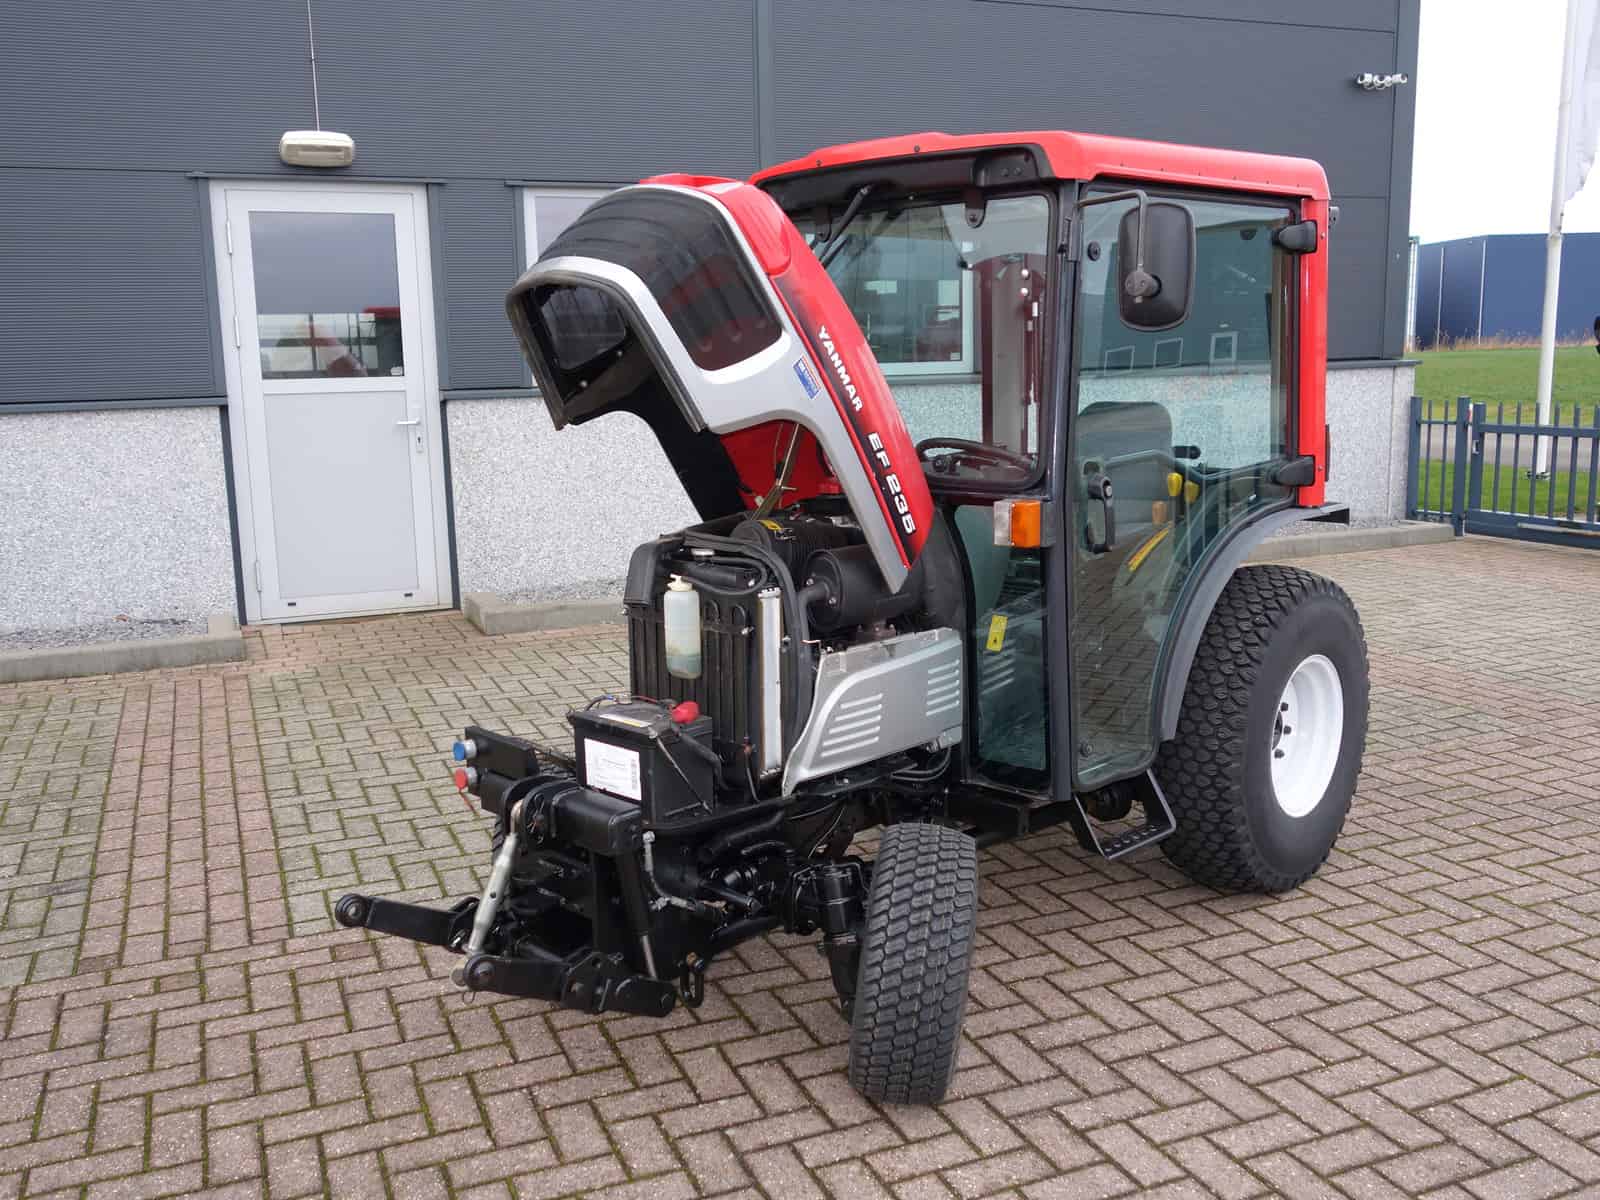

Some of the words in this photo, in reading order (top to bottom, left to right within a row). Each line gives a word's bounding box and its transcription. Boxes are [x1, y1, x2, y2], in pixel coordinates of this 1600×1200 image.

[818, 325, 863, 412] YANMAR
[868, 432, 891, 469] EF
[886, 474, 916, 534] 235
